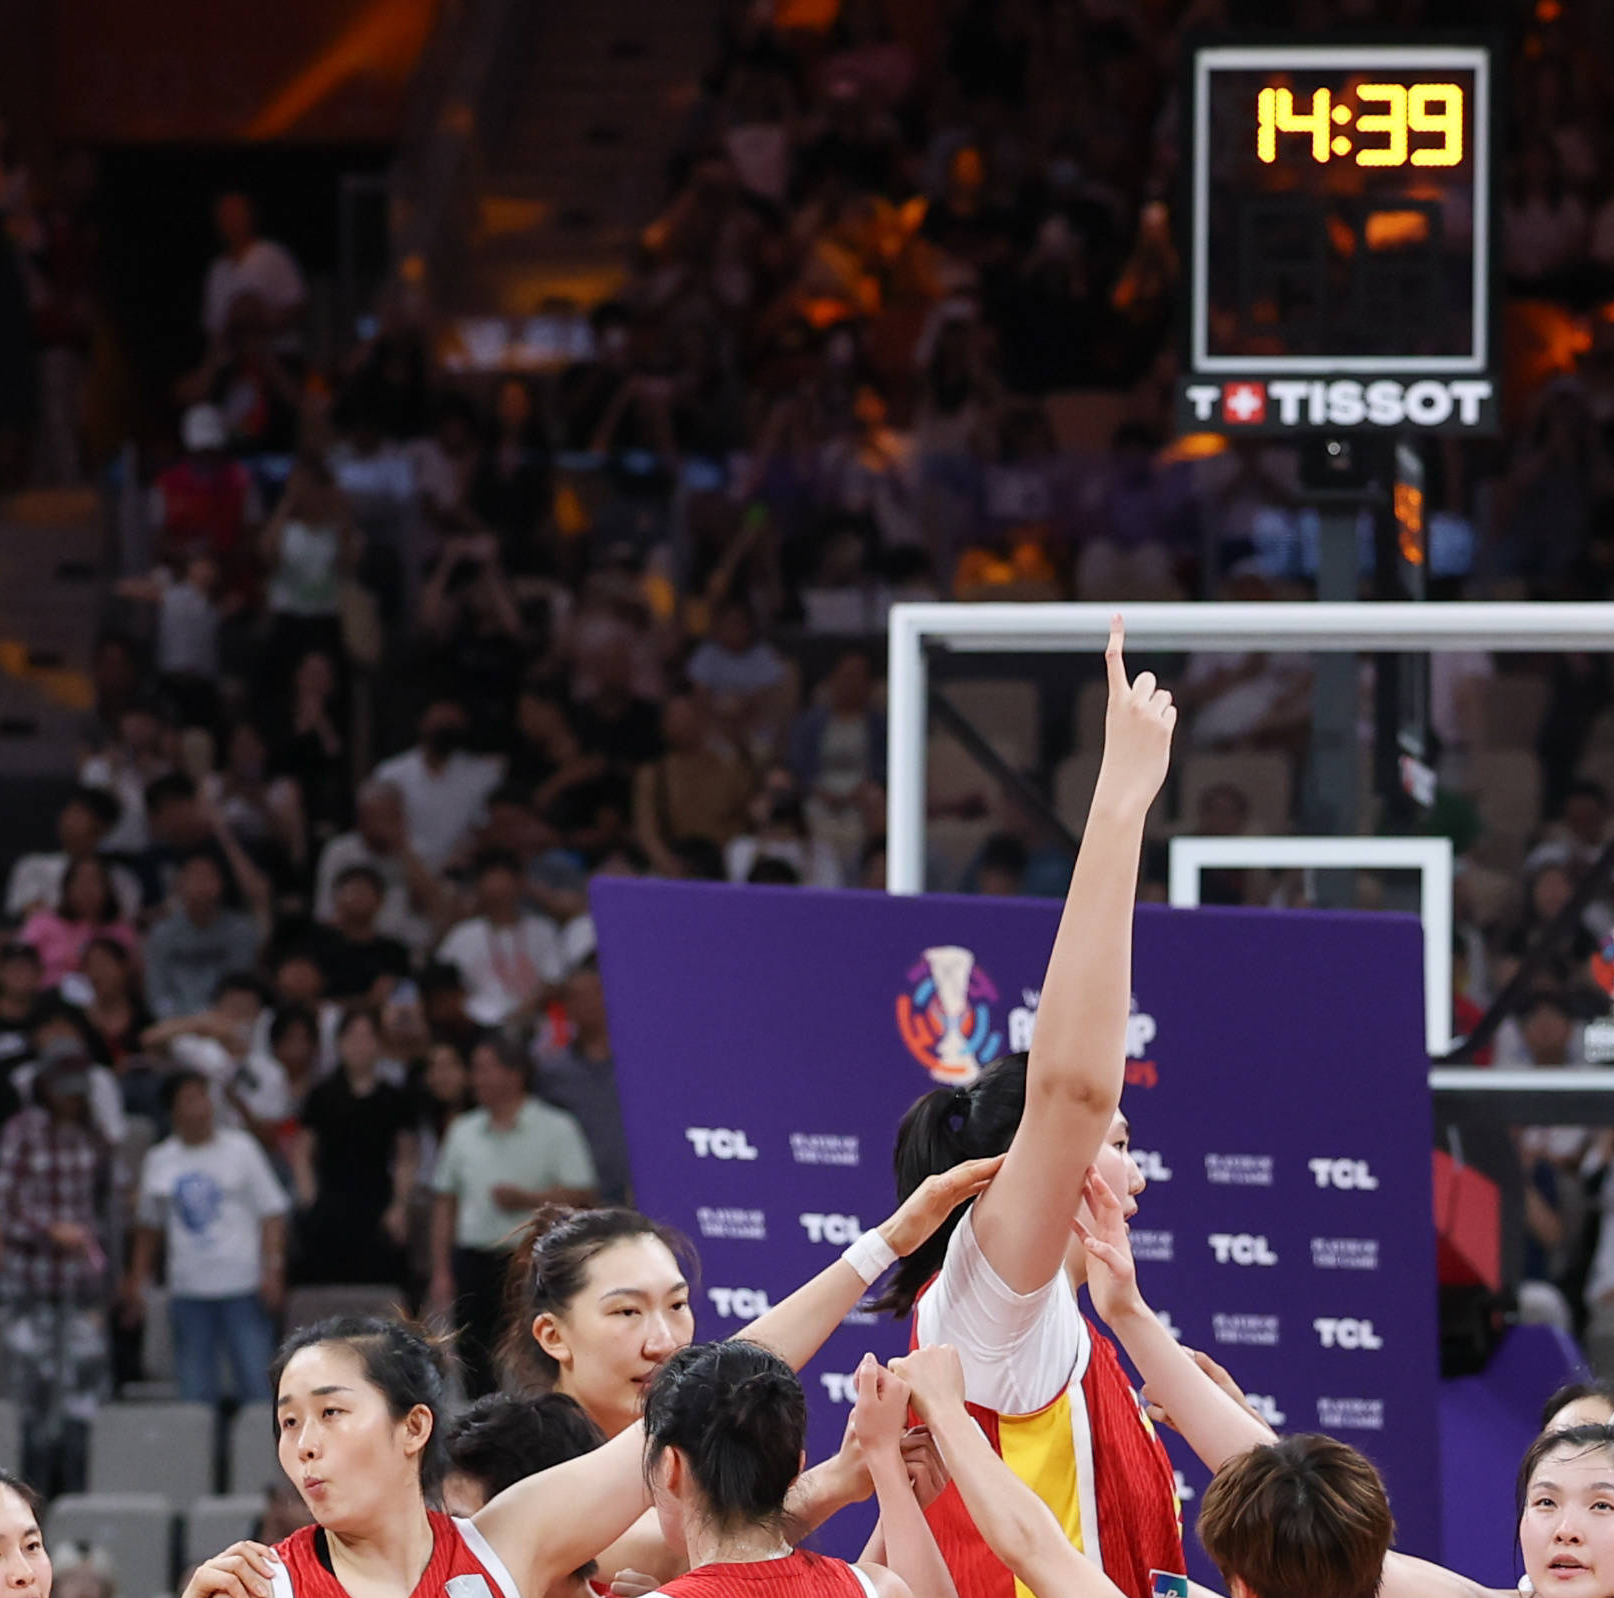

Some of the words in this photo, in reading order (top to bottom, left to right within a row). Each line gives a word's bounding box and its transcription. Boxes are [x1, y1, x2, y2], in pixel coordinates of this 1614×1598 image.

[1257, 83, 1463, 166] 14:39
[1268, 379, 1492, 426] TISSOT
[685, 1127, 758, 1160] TCL
[1130, 1150, 1173, 1182] CL
[1307, 1157, 1379, 1191] TCL
[1208, 1233, 1278, 1266] TCL
[1313, 1317, 1383, 1350] TCL
